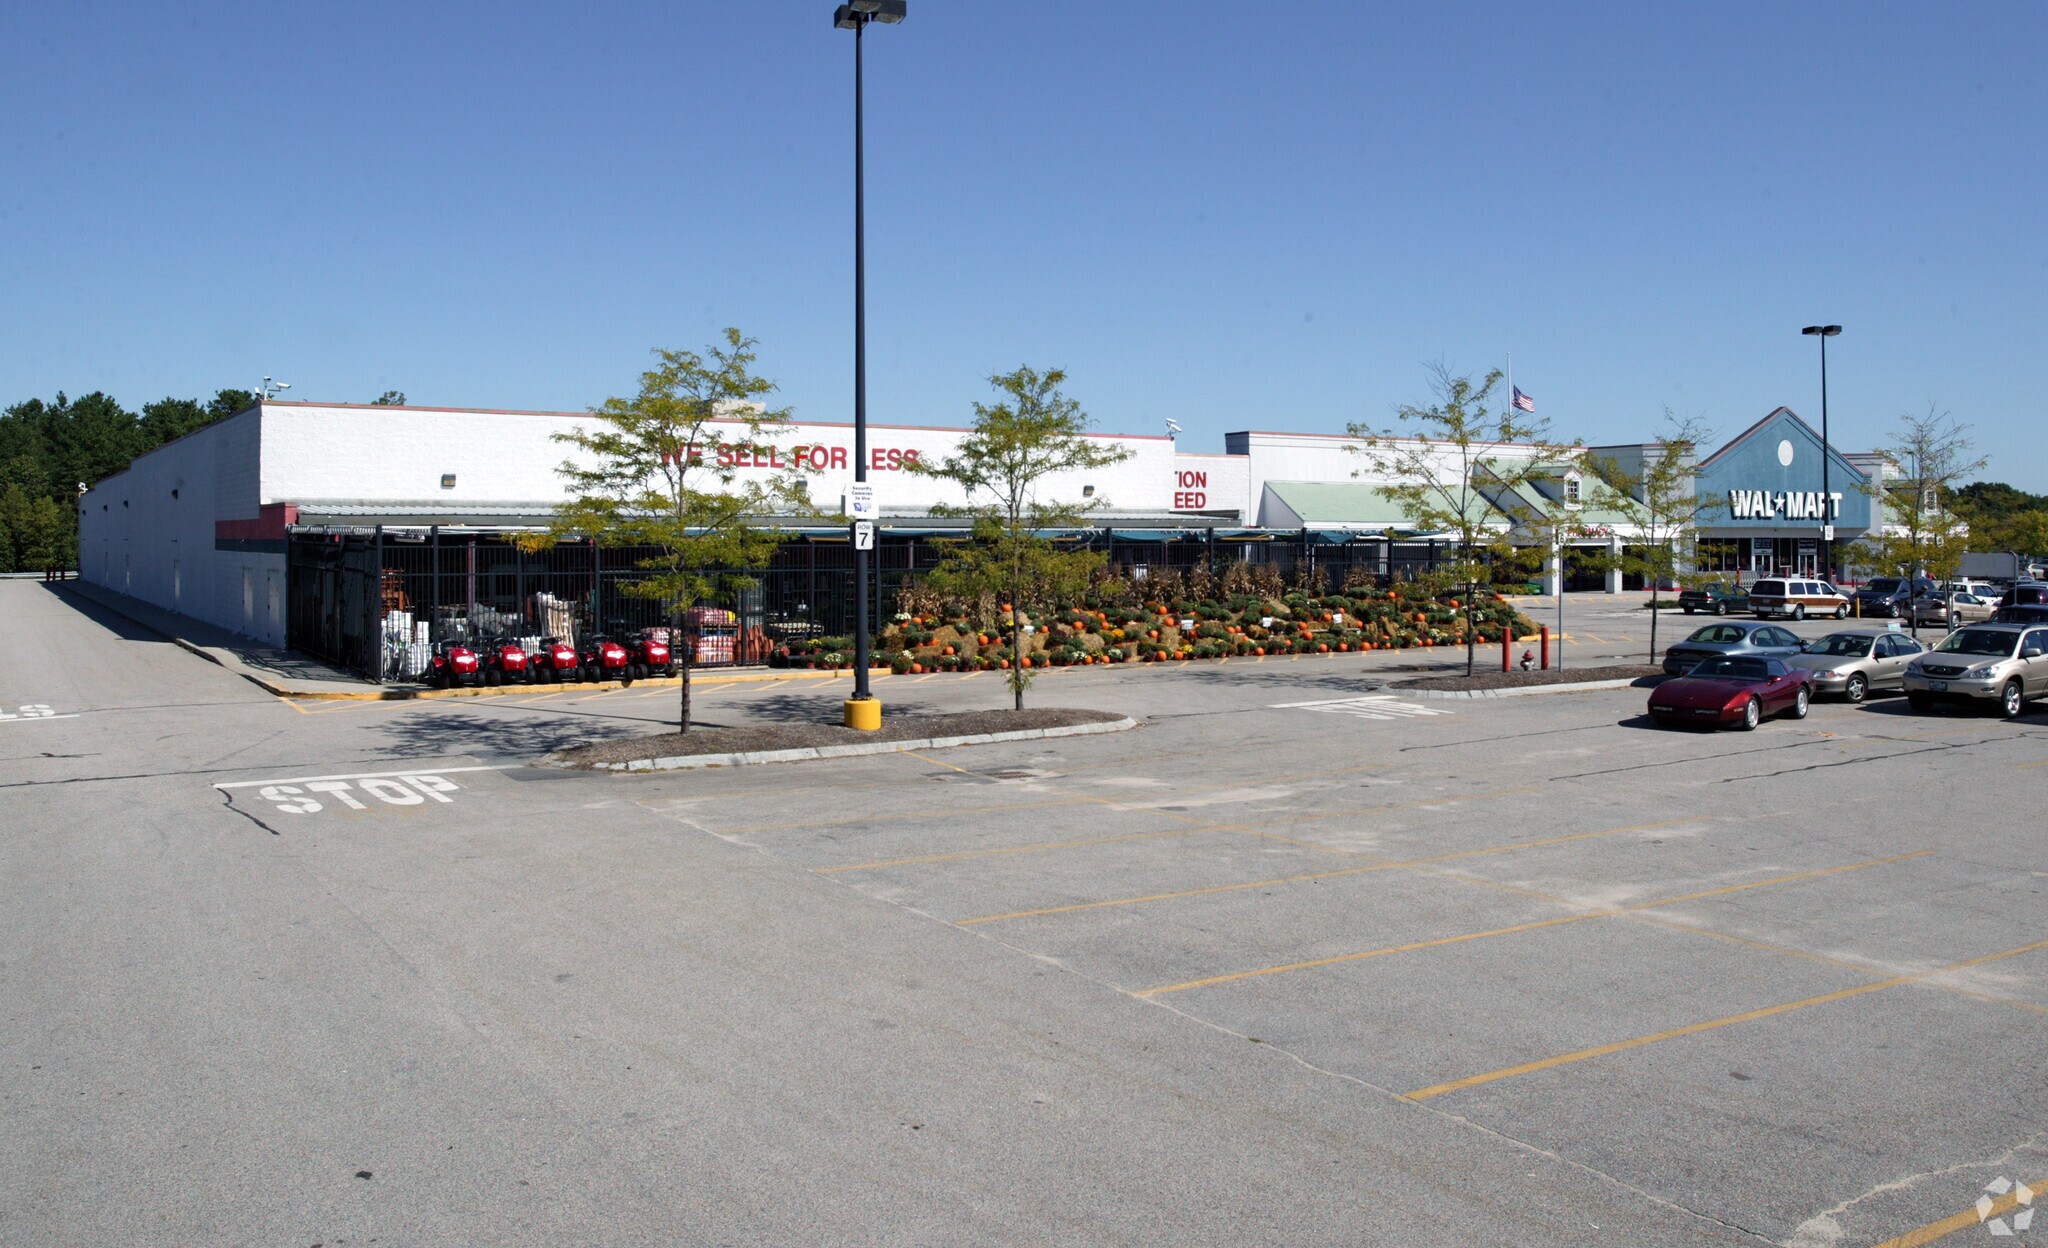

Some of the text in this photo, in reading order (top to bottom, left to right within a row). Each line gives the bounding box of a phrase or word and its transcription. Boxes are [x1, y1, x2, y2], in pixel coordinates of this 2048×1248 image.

[716, 443, 785, 468] SELL
[794, 445, 847, 470] FOR
[865, 448, 919, 471] ESS
[1175, 471, 1207, 488] ION
[859, 532, 868, 546] 7
[260, 775, 460, 814] STOP
